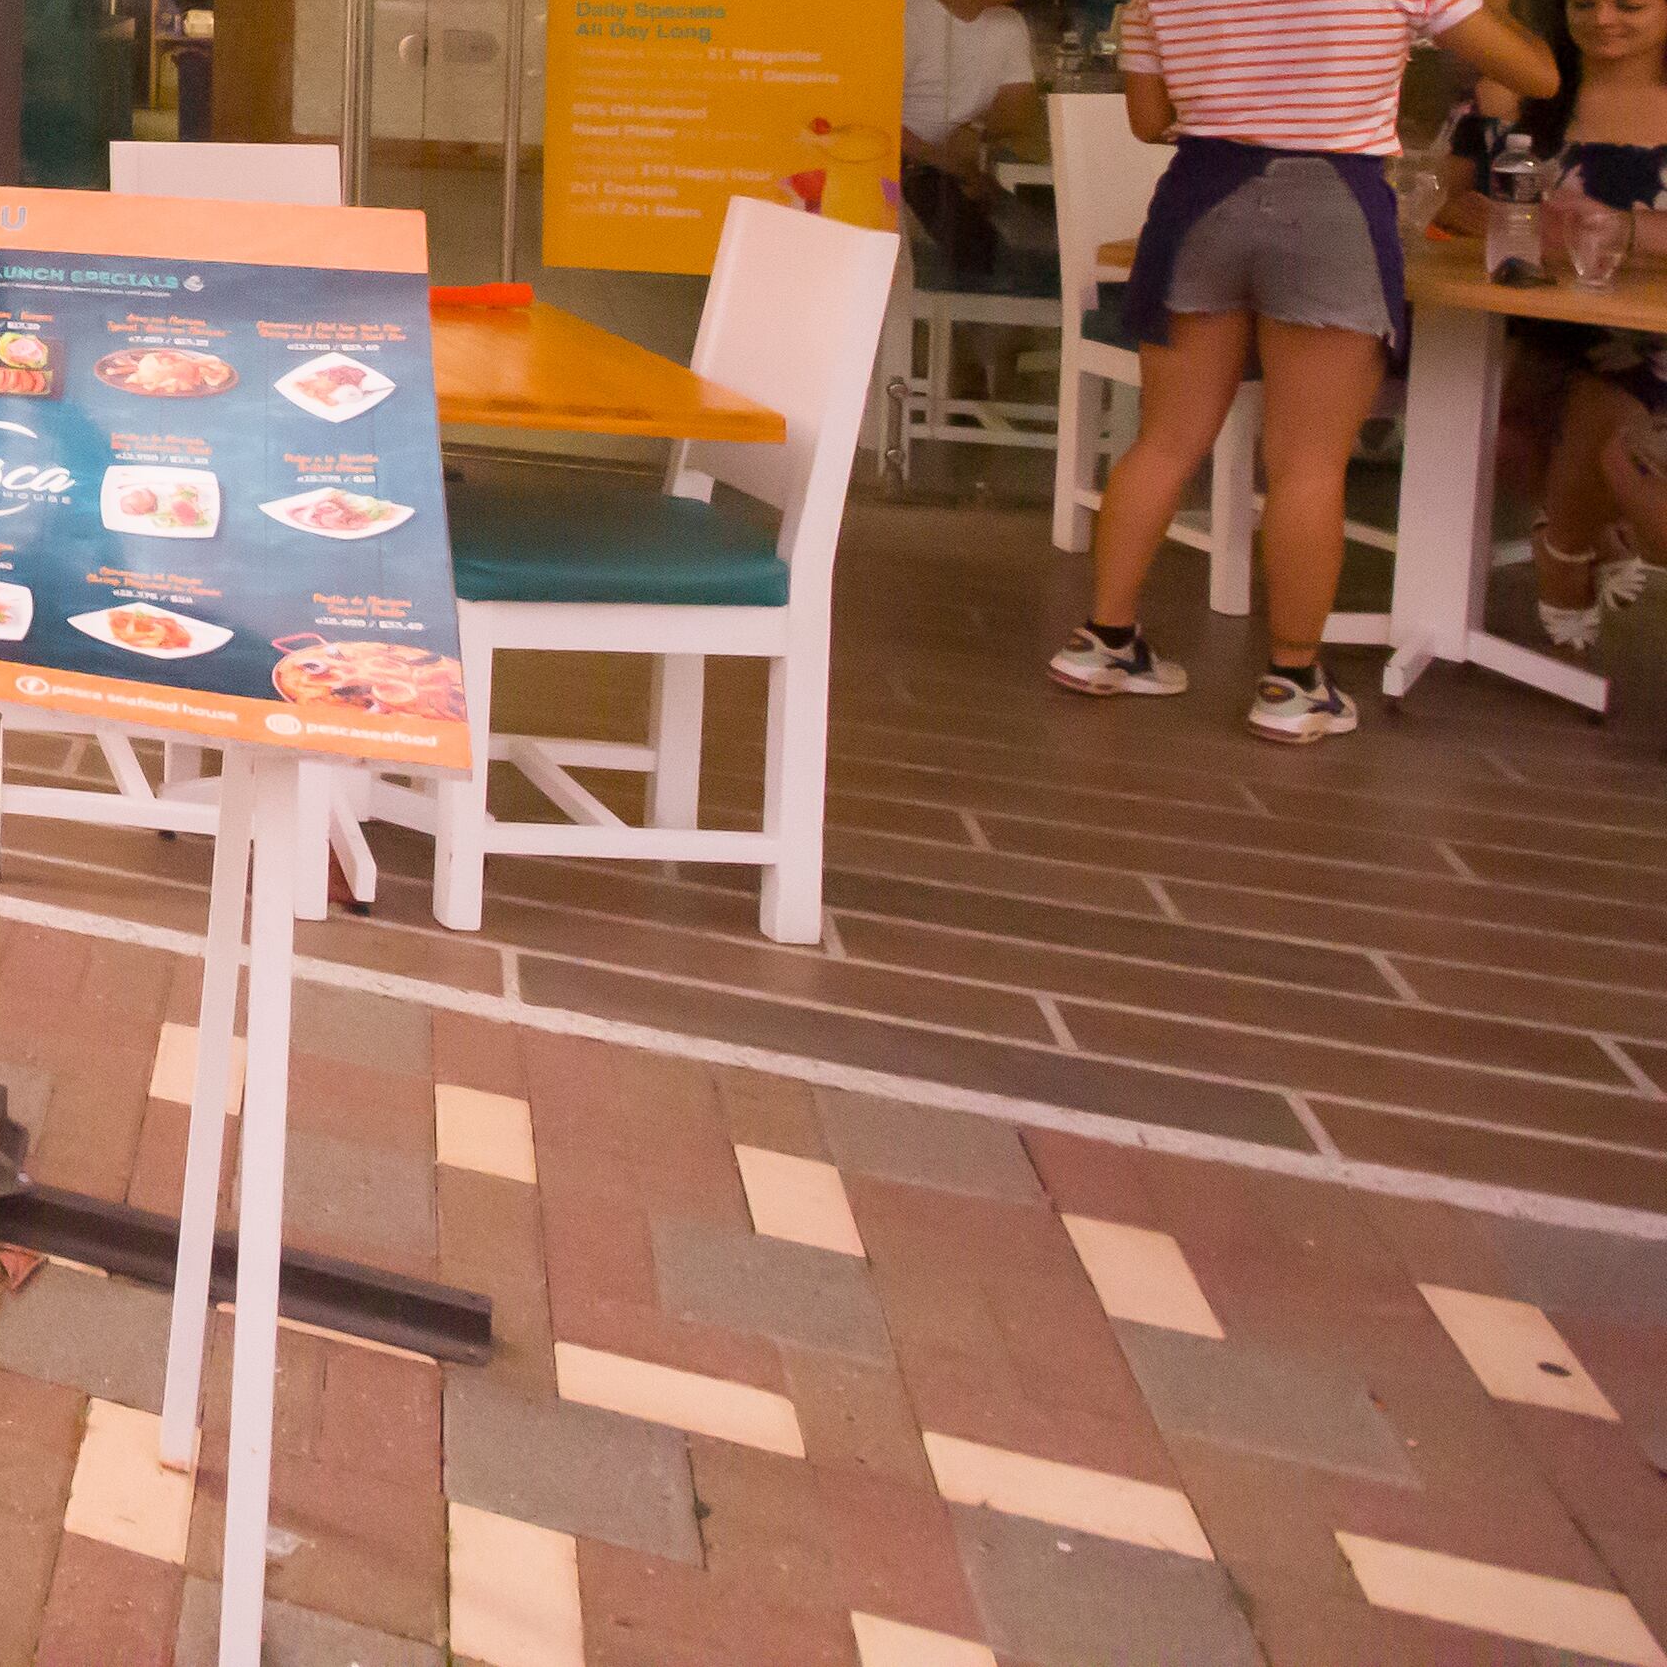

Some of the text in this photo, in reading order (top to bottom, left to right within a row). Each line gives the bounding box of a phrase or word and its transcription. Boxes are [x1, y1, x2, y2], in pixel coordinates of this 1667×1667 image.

[575, 0, 627, 20] Daily
[575, 22, 712, 43] All Day Long
[70, 269, 180, 290] SPECIALS
[51, 684, 238, 722] pesca seafood house
[305, 720, 437, 748] pescaseafood
